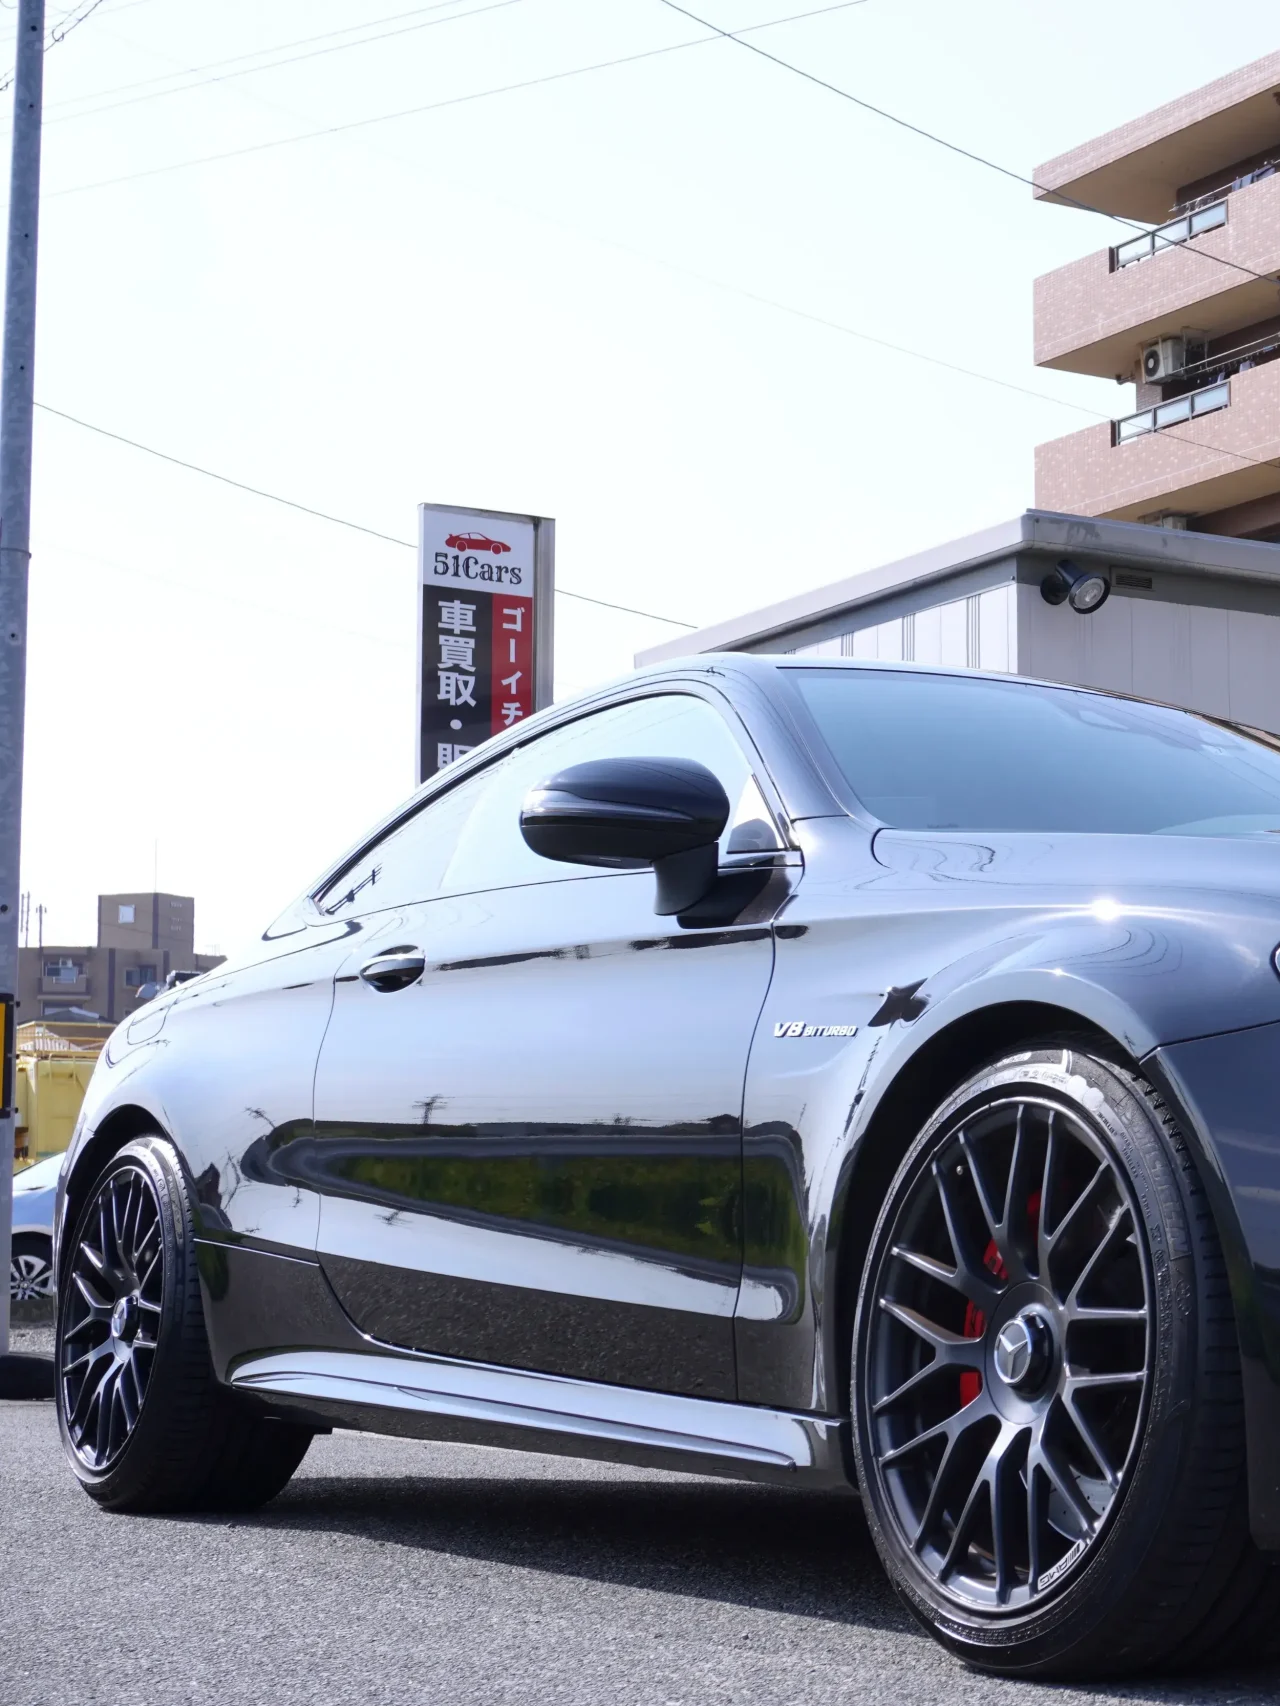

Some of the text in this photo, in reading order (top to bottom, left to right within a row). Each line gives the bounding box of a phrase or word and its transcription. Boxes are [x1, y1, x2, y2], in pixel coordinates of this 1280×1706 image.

[433, 551, 523, 585] 51Cars
[501, 607, 525, 726] ゴーイチ
[774, 1021, 859, 1038] V8 BITURBO
